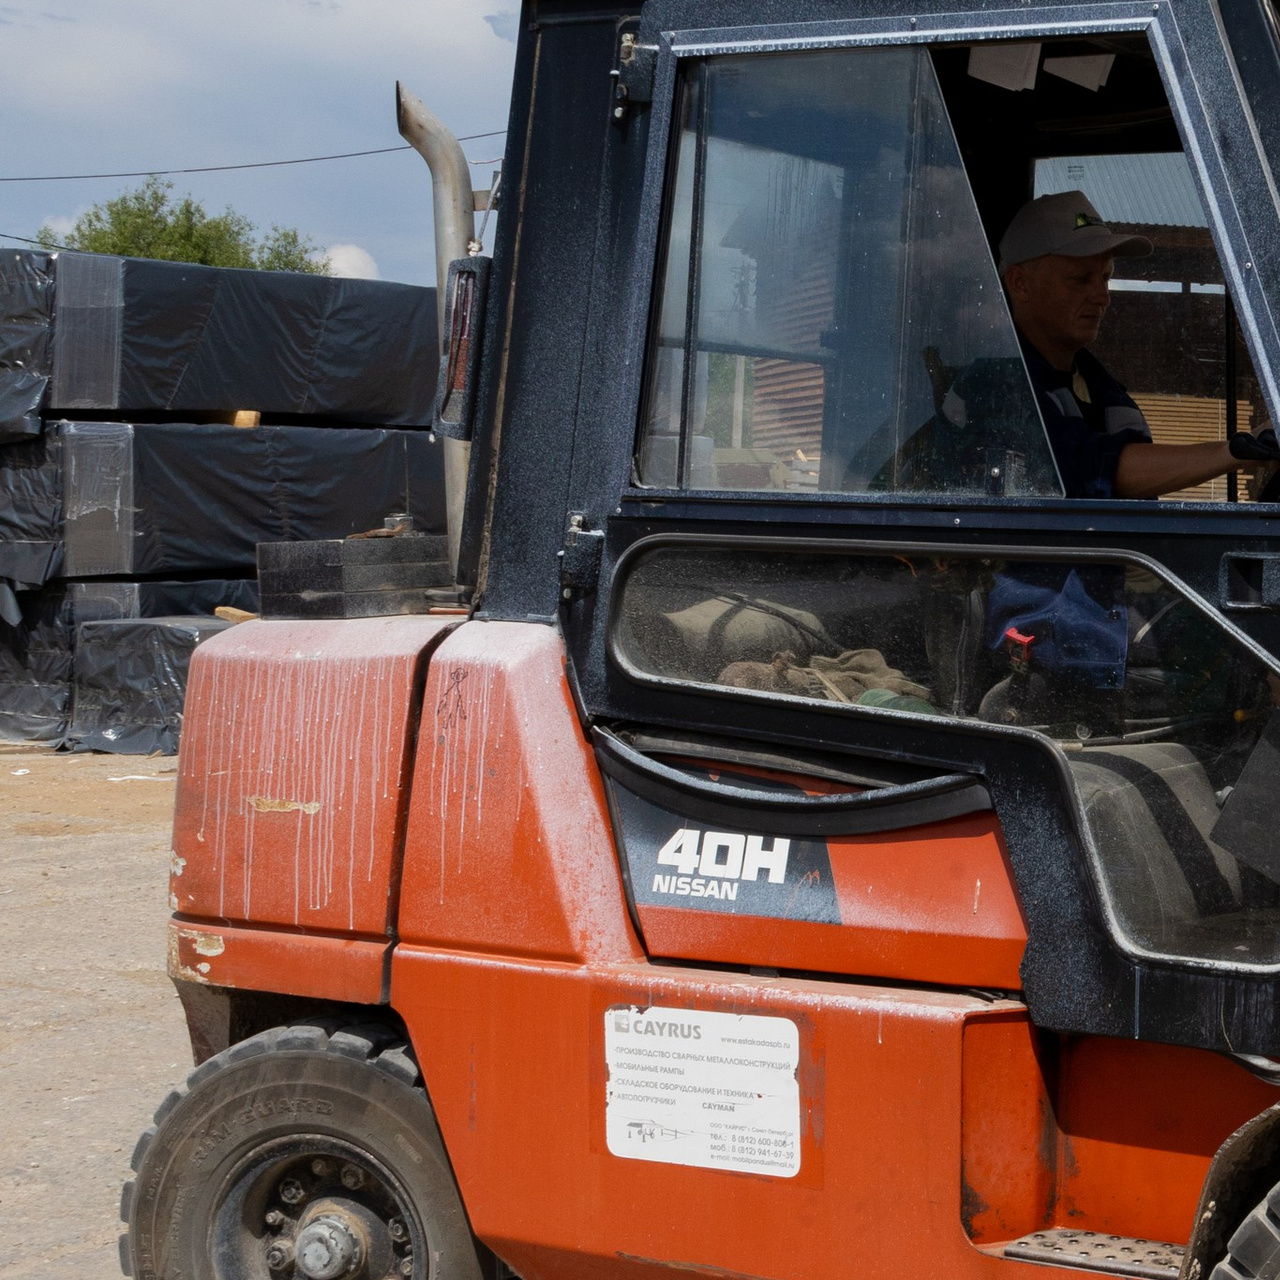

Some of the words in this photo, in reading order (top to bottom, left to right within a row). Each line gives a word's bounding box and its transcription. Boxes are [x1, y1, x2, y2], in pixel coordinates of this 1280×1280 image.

[657, 828, 790, 884] 40H
[652, 874, 738, 900] NISSAN
[633, 1019, 702, 1040] CAYRUS
[720, 1036, 791, 1049] www.estakadaspb.ru
[672, 1052, 705, 1062] СВАРНЫХ
[706, 1055, 791, 1070] МЕТАЛЛОКОНСТРУКЦИЙ
[660, 1066, 685, 1075] РАМПЫ
[660, 1082, 715, 1095] ОБОРУДОВАНИЕ
[723, 1089, 755, 1099] ТЕХНИКА
[702, 1102, 735, 1112] CAYMAN
[731, 1134, 737, 1143] 8
[738, 1135, 756, 1146] (812)
[731, 1145, 737, 1153] 8
[738, 1146, 756, 1156] (812)
[757, 1149, 794, 1160] 941-67-39
